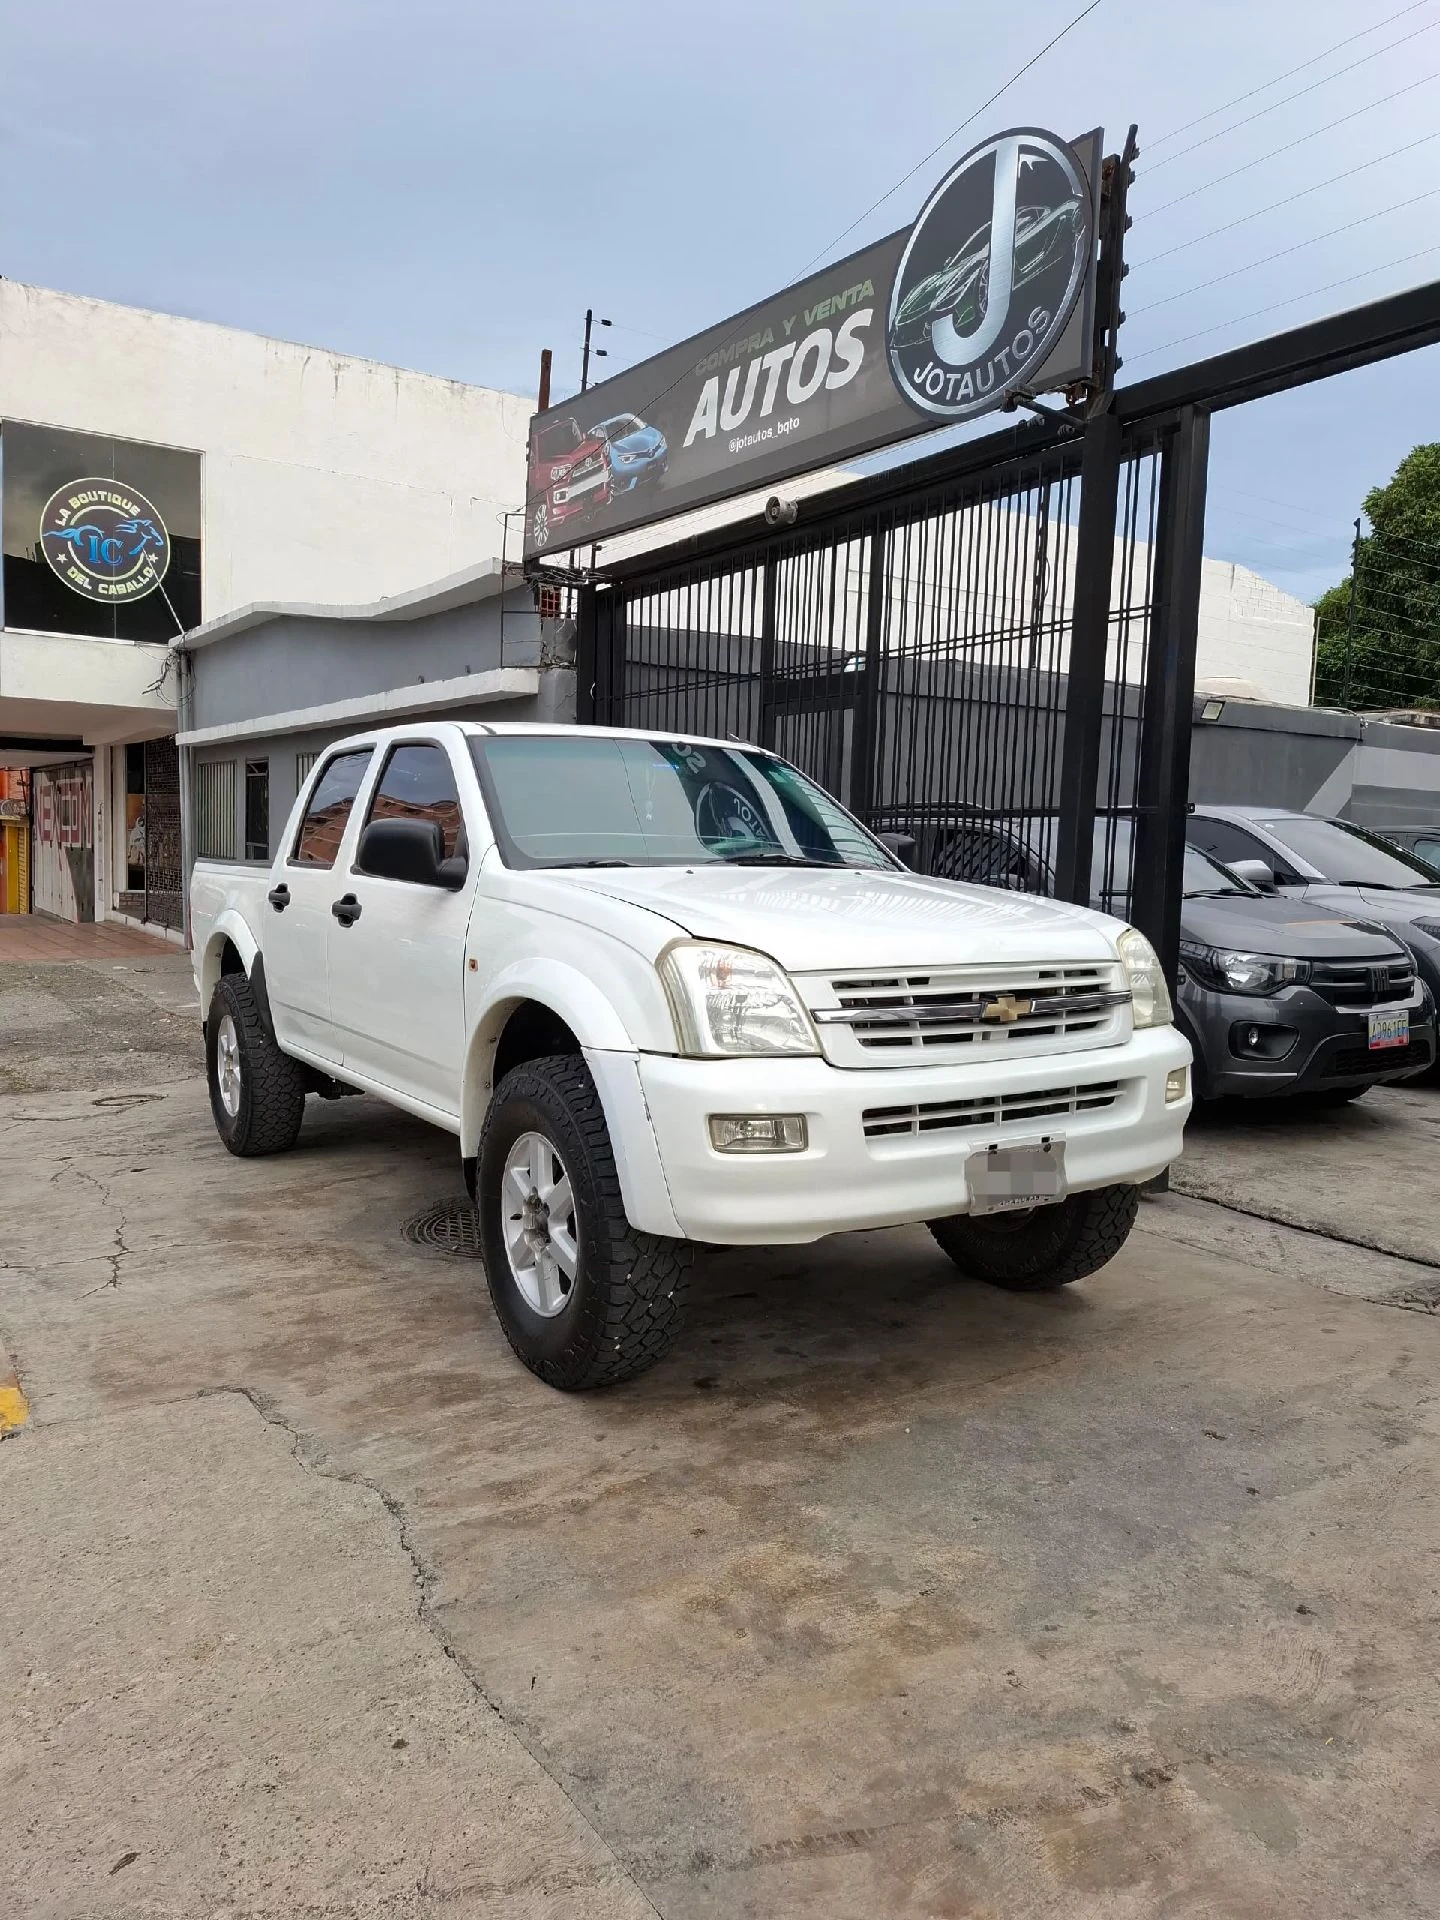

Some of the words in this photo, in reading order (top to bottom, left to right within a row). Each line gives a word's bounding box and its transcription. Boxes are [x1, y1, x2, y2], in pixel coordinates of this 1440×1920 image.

[695, 327, 775, 377] COMPRA
[782, 314, 798, 337] Y
[804, 279, 875, 327] VENTA
[913, 305, 1051, 401] JOTAUTOS
[682, 308, 874, 448] AUTOS
[55, 508, 72, 527] LA
[68, 490, 141, 517] BOUTIQUE
[67, 565, 92, 591] DEL
[97, 565, 154, 595] CABALLO
